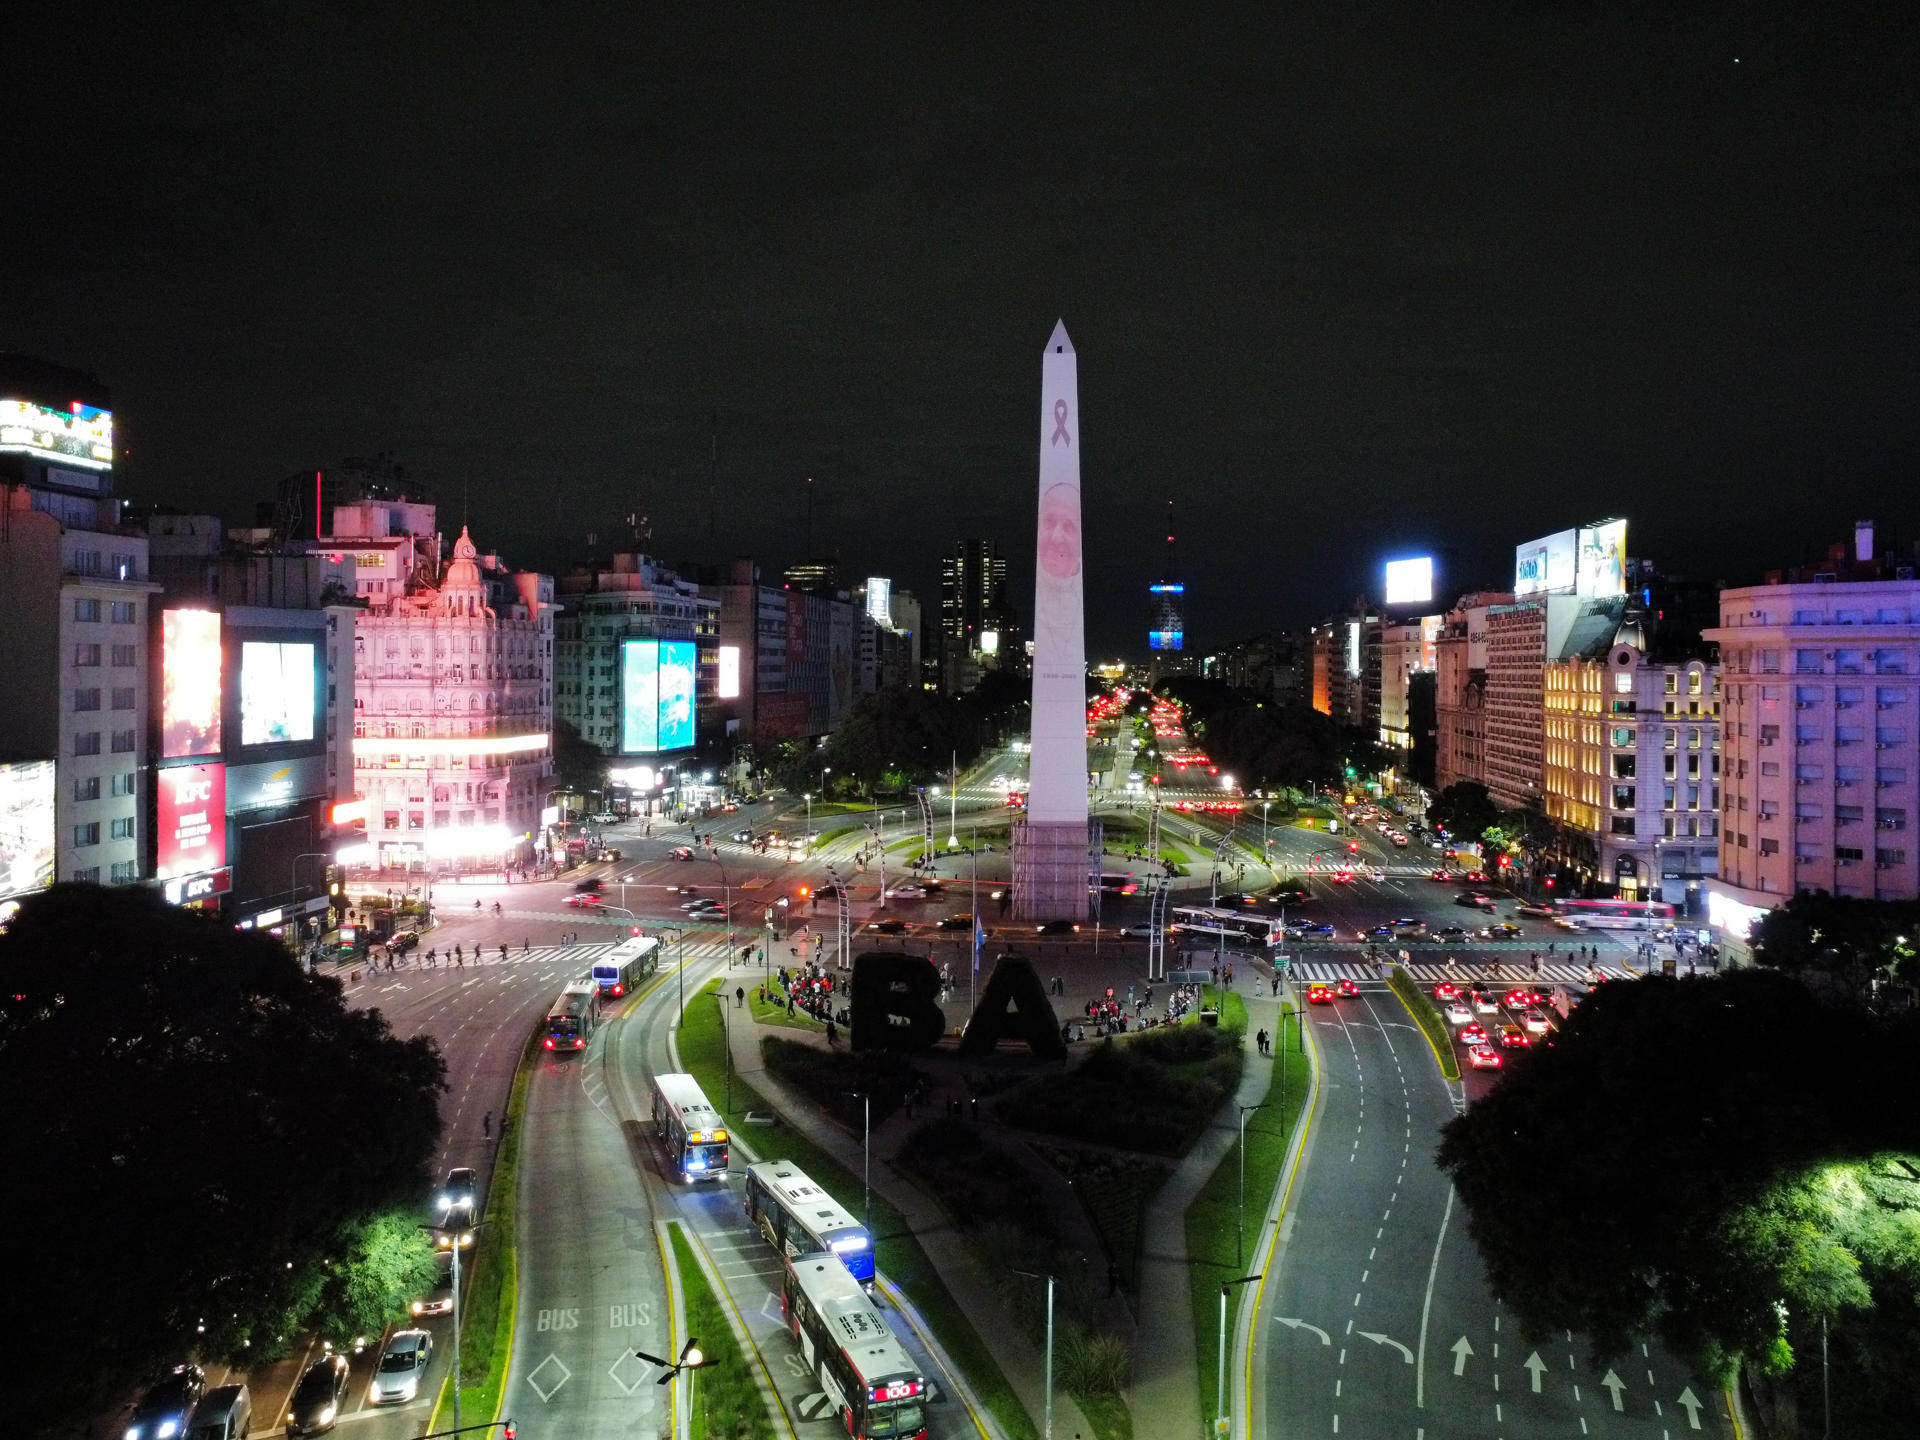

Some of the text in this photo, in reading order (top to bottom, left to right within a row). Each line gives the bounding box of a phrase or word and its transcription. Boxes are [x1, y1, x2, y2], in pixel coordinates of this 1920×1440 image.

[174, 780, 212, 806] KFC
[188, 877, 214, 896] KFC
[701, 1131, 714, 1142] 59
[537, 1308, 580, 1332] BUS
[609, 1303, 650, 1329] BUS
[886, 1385, 911, 1400] 100
